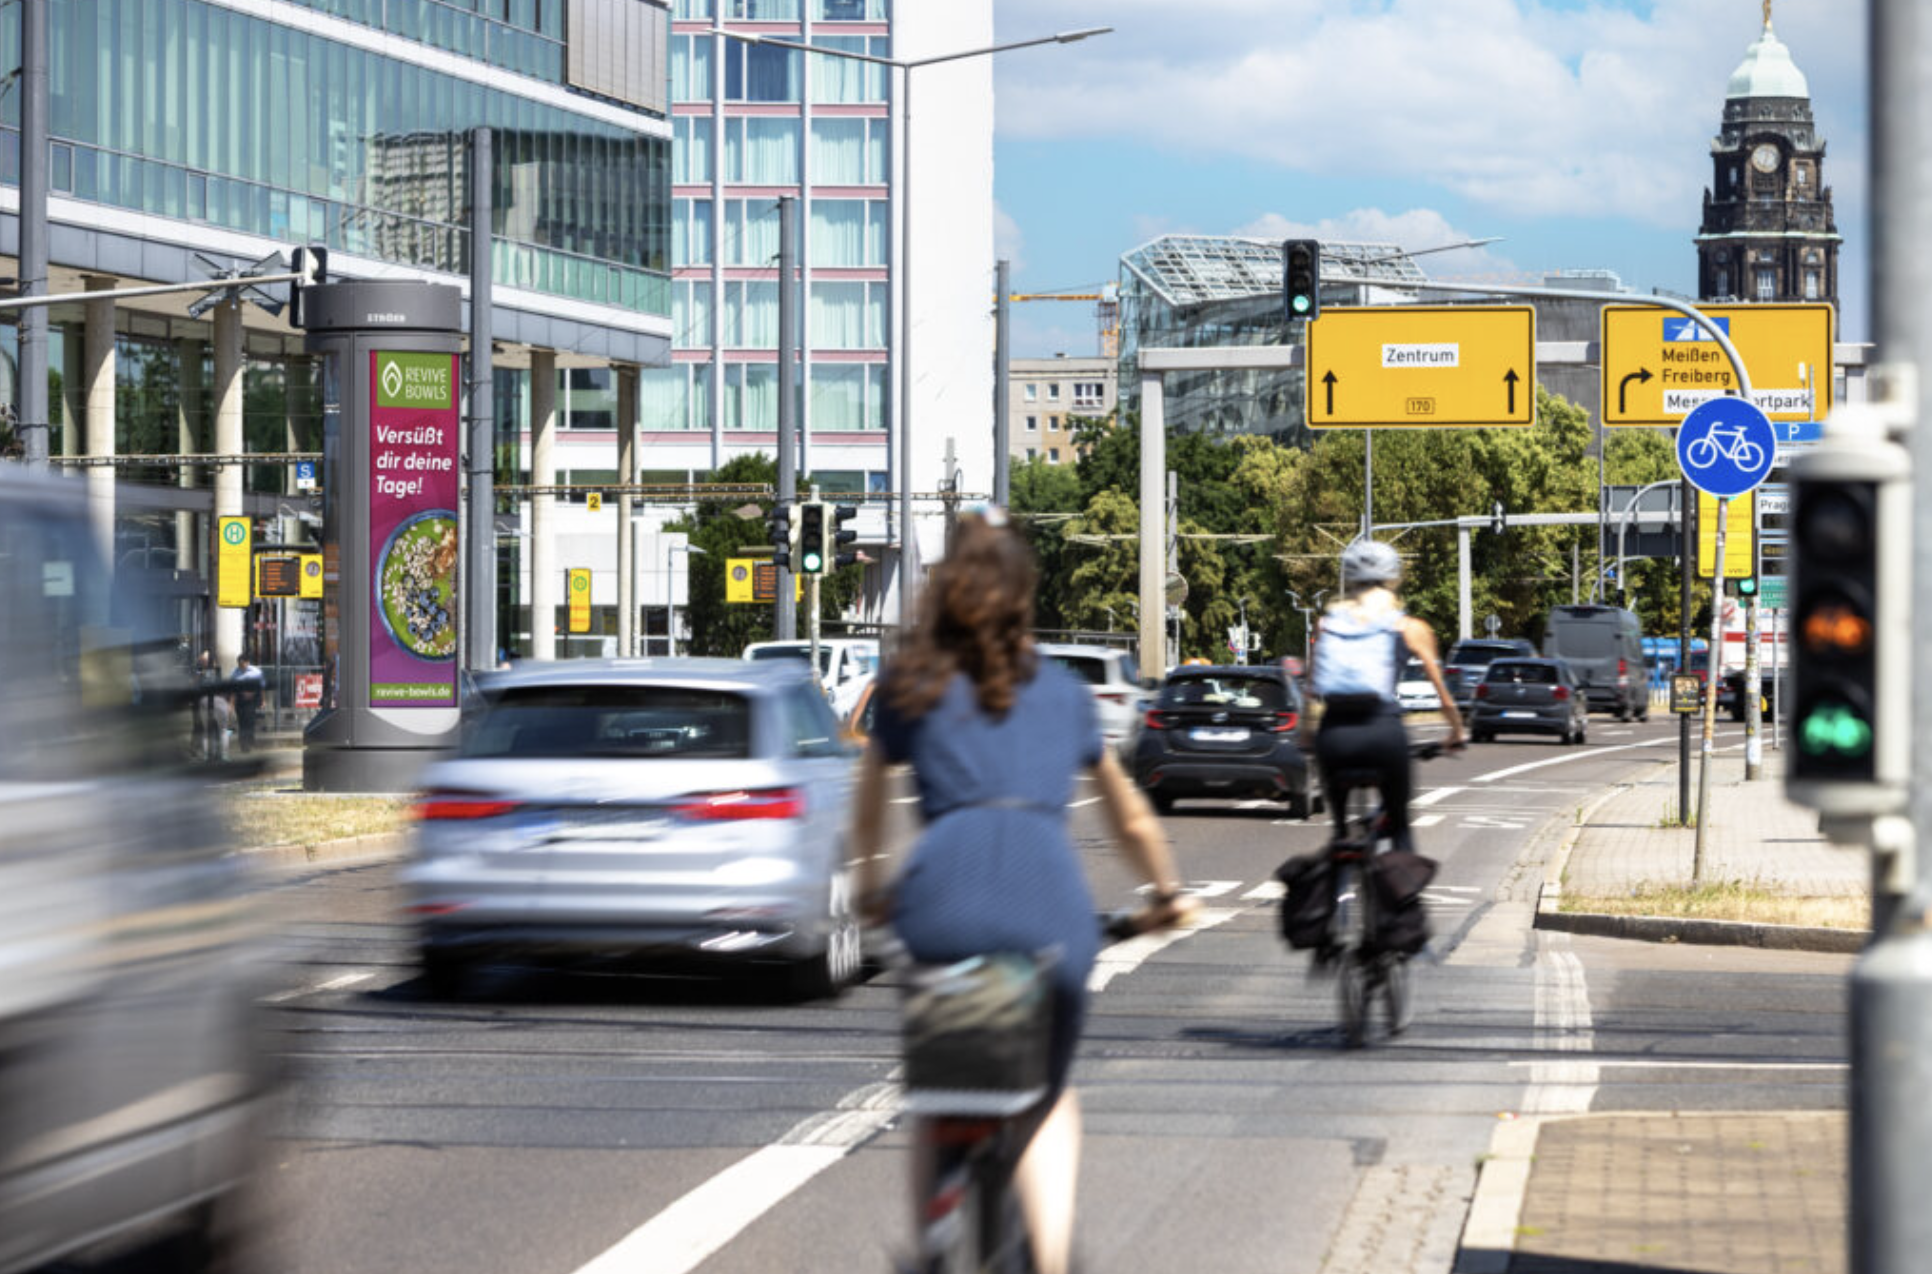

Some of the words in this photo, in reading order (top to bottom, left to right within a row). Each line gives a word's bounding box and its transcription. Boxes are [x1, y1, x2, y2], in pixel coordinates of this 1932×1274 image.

[1387, 347, 1455, 362] Zentrum
[1662, 348, 1720, 362] Meißen
[405, 366, 447, 383] REVIVE
[1662, 369, 1731, 386] Freiberg
[405, 384, 447, 400] BOWLS
[1411, 400, 1431, 411] 170
[1667, 394, 1709, 408] Mes
[376, 425, 444, 445] Versüßt
[1788, 424, 1800, 441] P
[376, 450, 402, 469] dir
[404, 451, 453, 471] deine
[300, 463, 312, 478] S
[376, 475, 424, 499] Tage!
[589, 495, 599, 508] 2
[1760, 499, 1788, 513] Prag
[376, 685, 451, 698] revive-bowls.de
